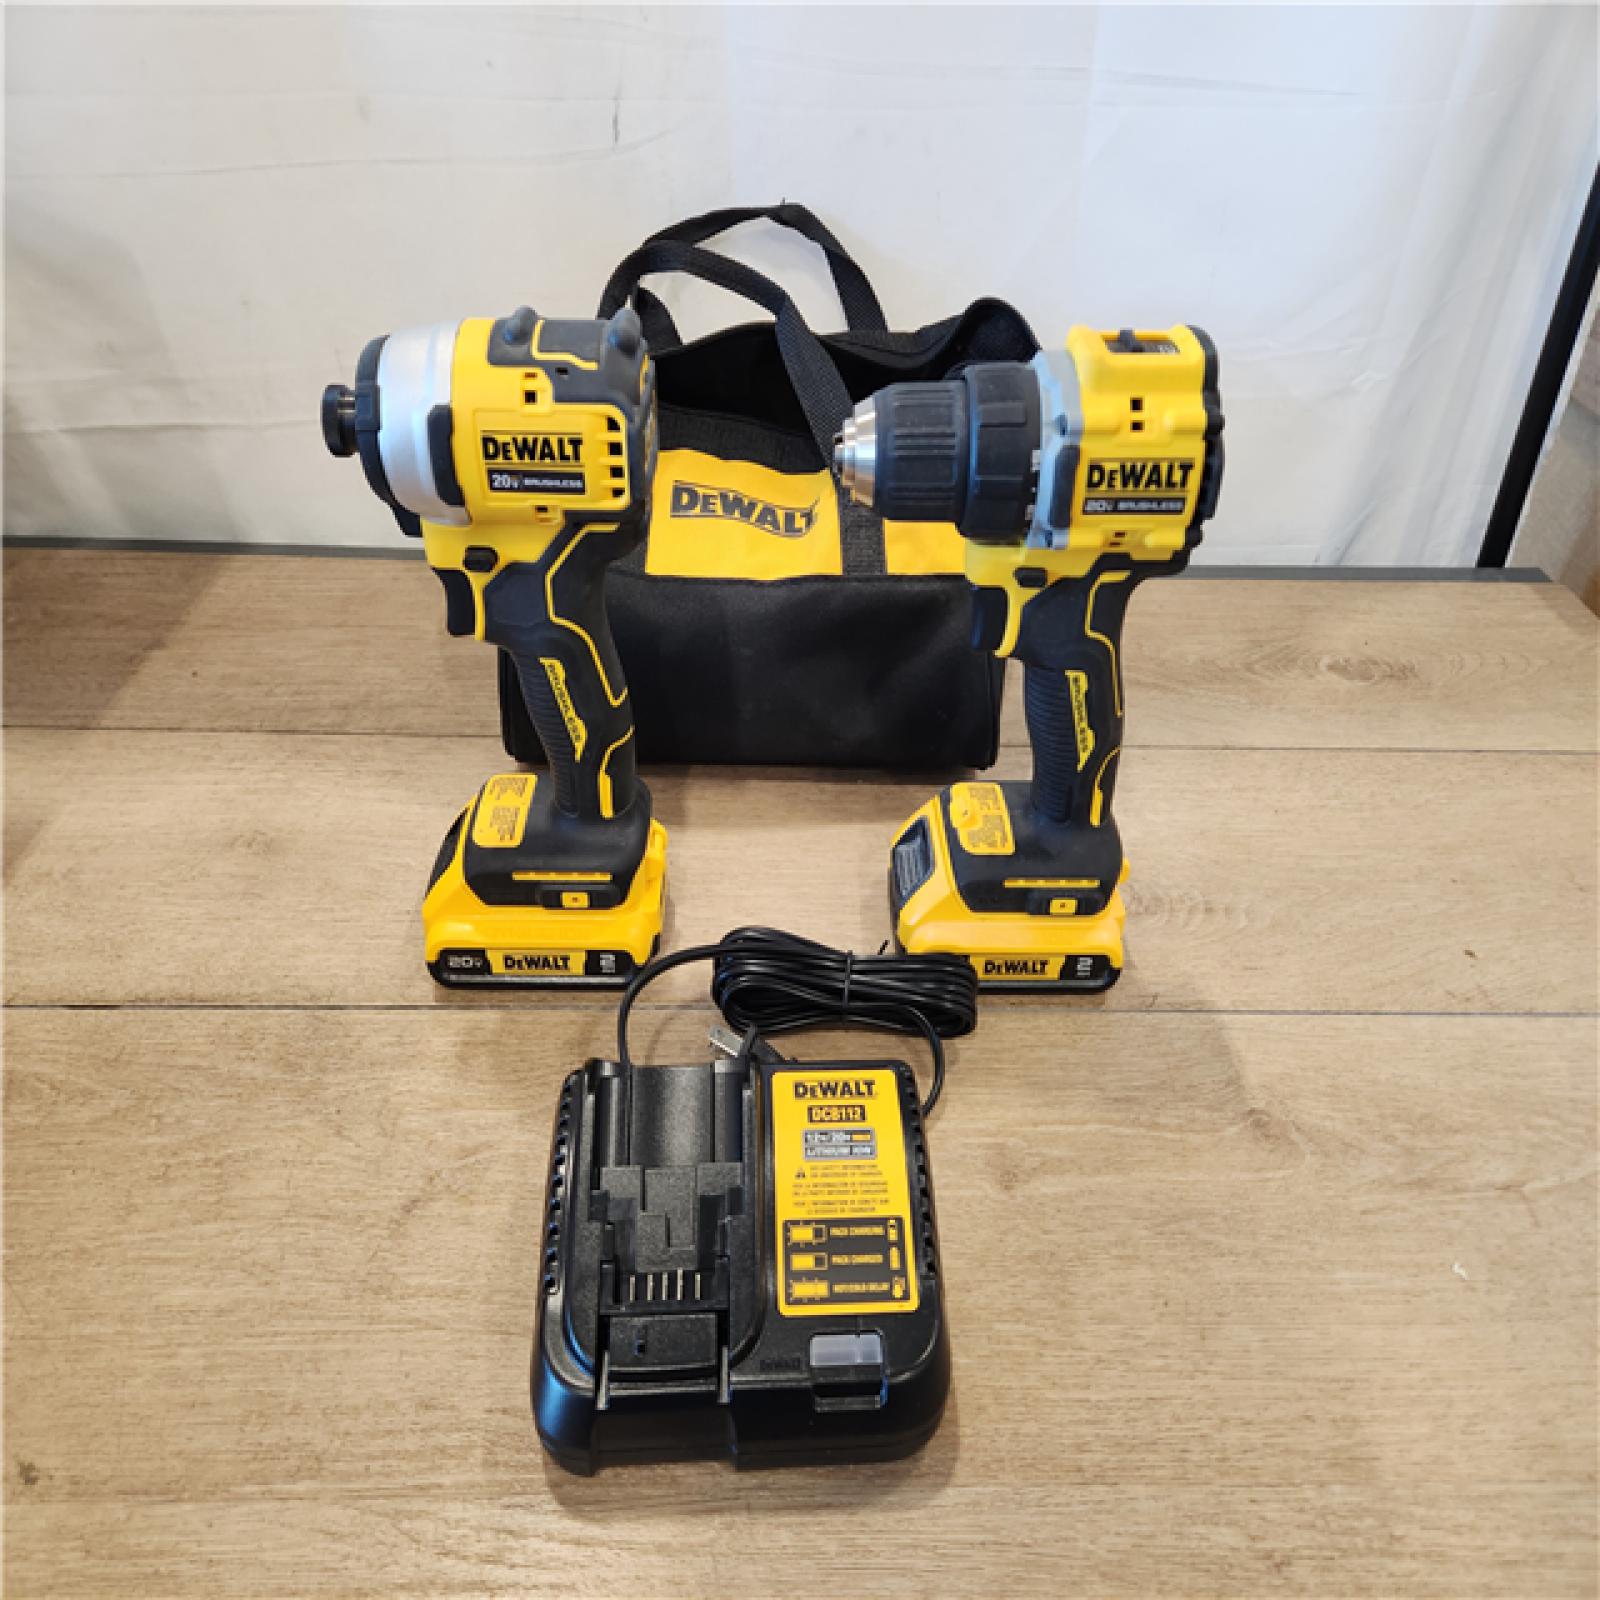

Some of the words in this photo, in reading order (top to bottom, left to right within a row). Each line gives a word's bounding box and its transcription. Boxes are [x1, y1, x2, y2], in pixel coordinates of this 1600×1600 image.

[482, 436, 583, 461] DEWALT
[1087, 463, 1195, 489] DEWALT
[671, 484, 818, 535] DEWALT
[503, 954, 571, 971] DEWALT
[984, 959, 1049, 976] DEWALT
[793, 1079, 877, 1099] DEWALT
